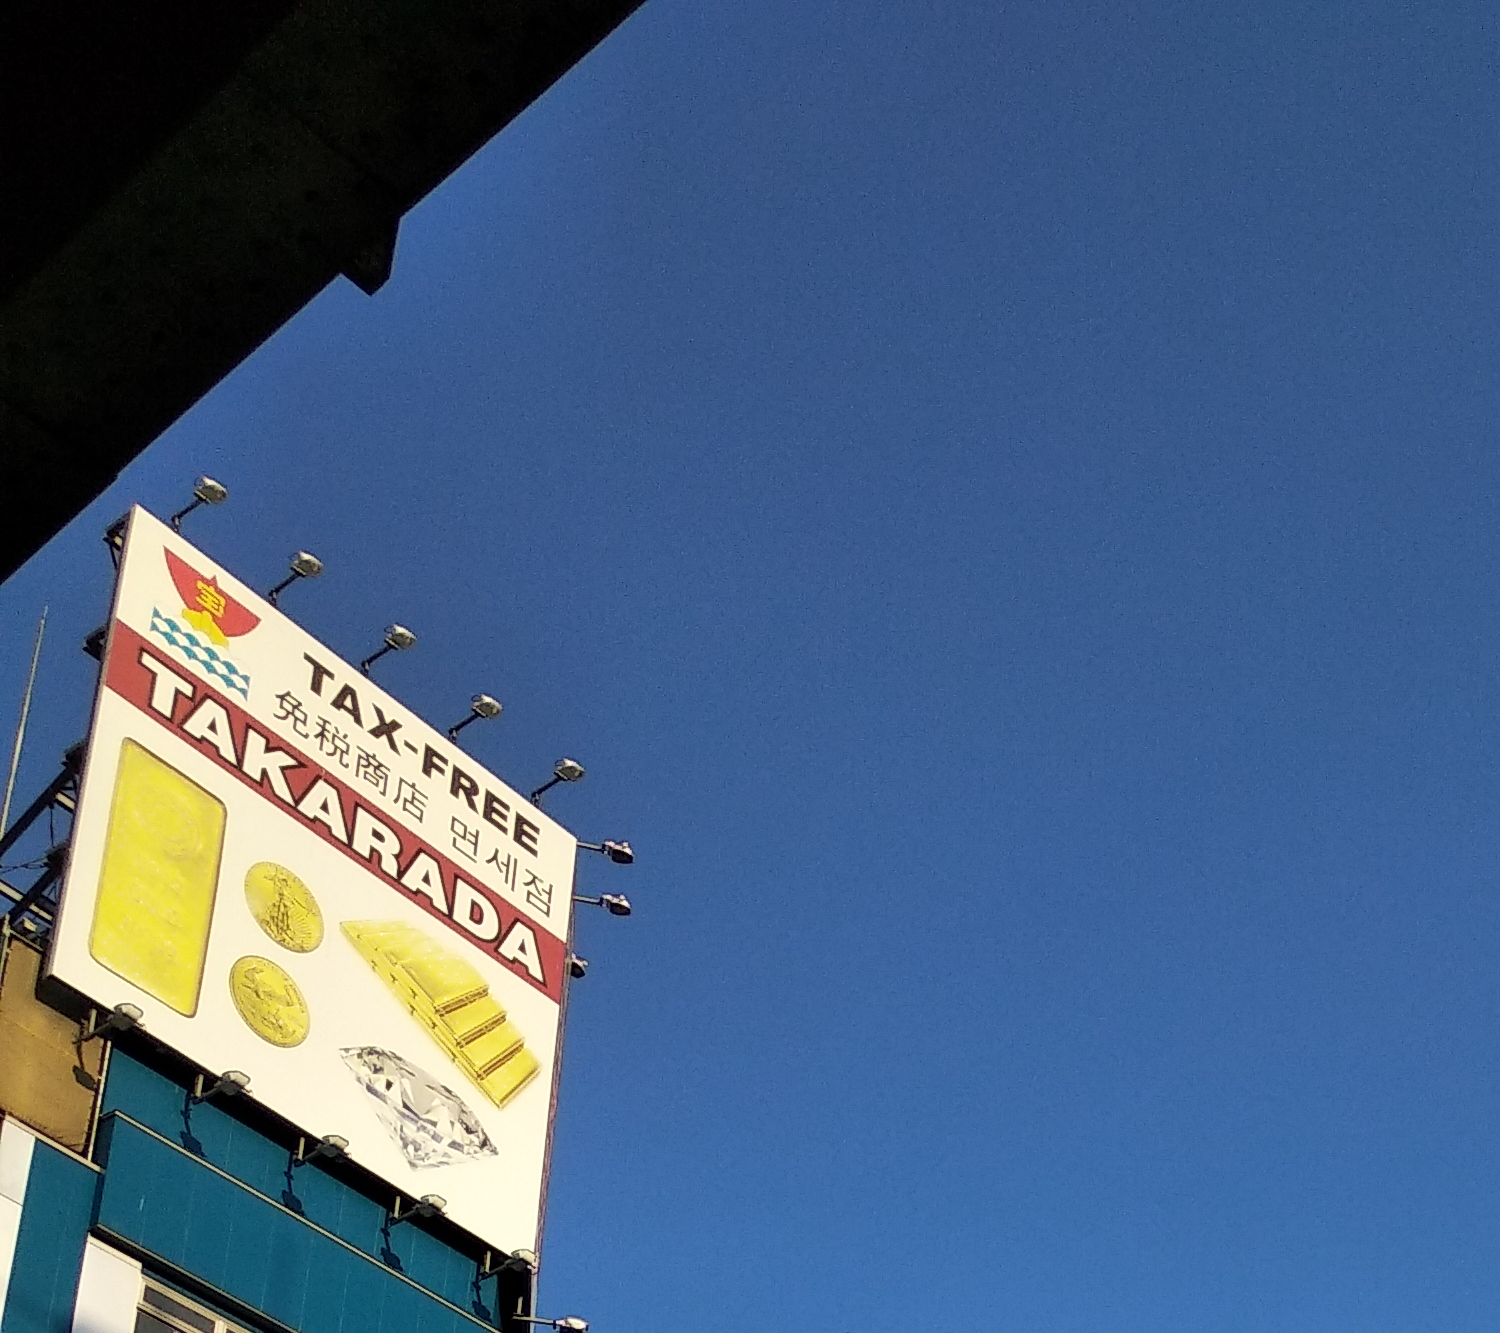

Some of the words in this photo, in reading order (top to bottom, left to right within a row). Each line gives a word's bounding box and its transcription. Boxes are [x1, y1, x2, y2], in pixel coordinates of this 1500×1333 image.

[139, 650, 547, 985] TAKARADA
[274, 689, 428, 823] 免税商店
[304, 654, 540, 858] TAX-FREE
[450, 819, 554, 918] 면세점
